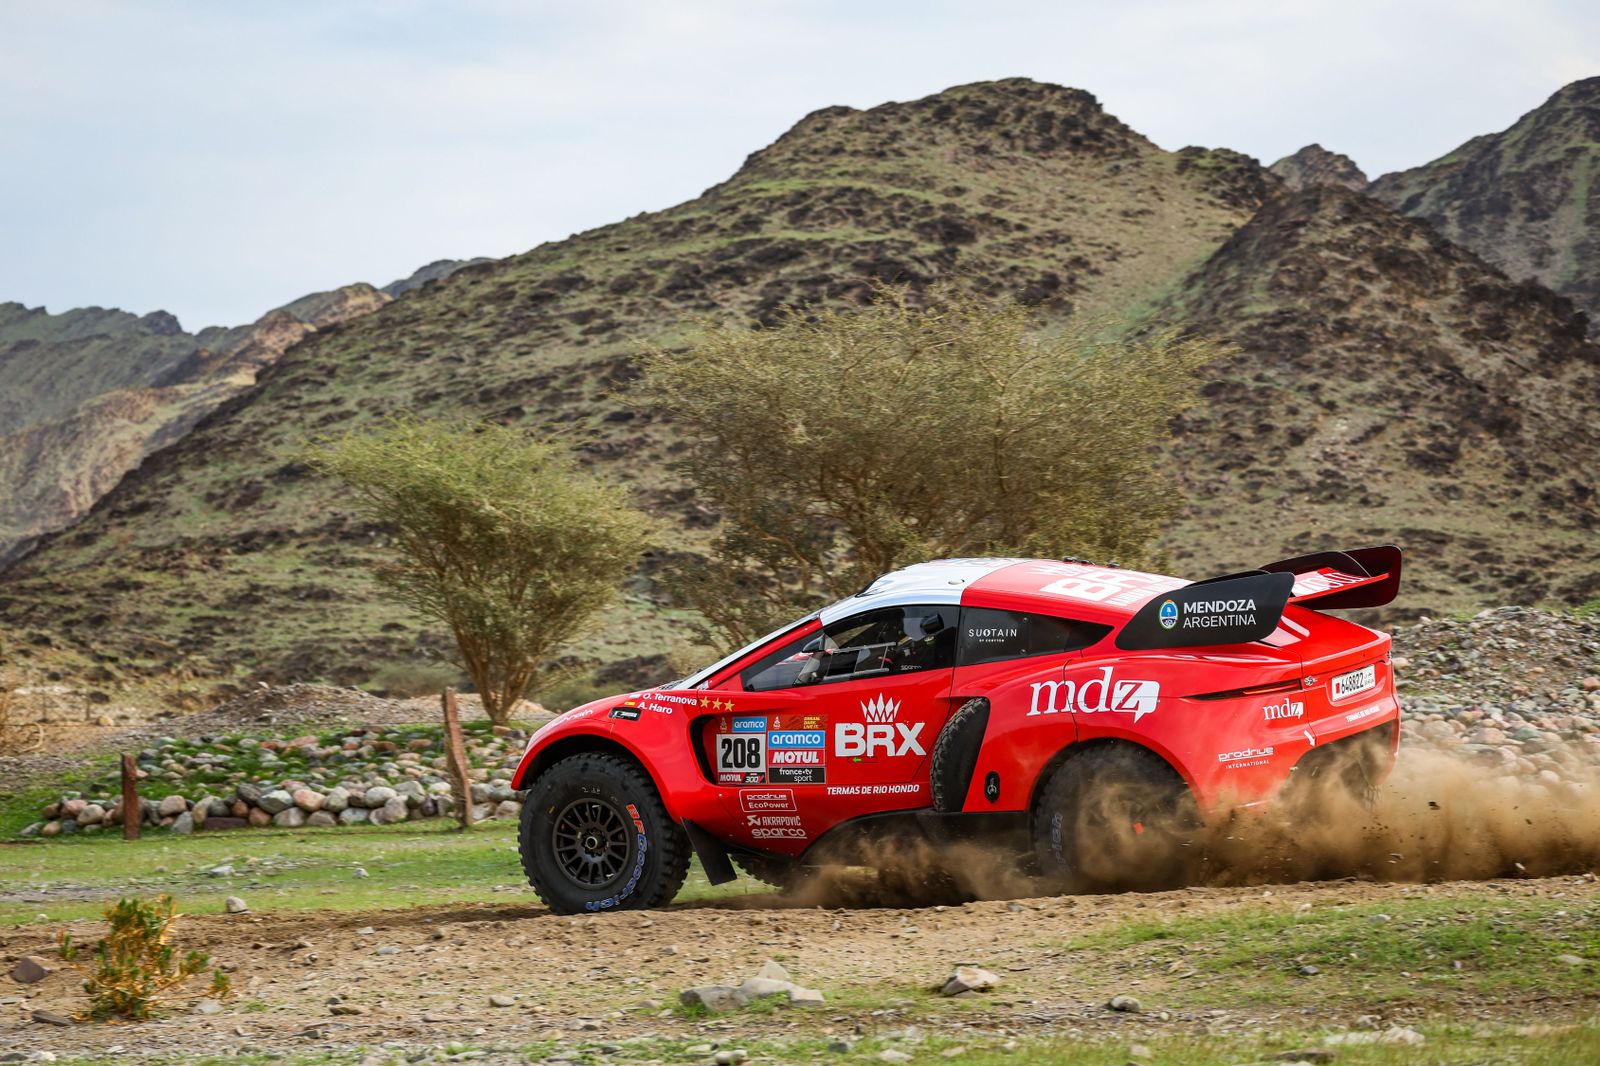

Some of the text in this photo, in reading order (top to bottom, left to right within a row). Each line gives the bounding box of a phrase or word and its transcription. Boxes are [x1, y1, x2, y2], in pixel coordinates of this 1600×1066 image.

[1183, 599, 1257, 614] MENDOZA
[1182, 613, 1257, 629] ARGENTINA
[642, 692, 698, 706] O. Terranova
[1026, 666, 1160, 720] mdz
[637, 701, 673, 715] A. Haro
[1262, 697, 1304, 720] mdz
[734, 720, 765, 729] aramco
[771, 733, 821, 745] aramco
[835, 722, 927, 758] BRX
[721, 738, 761, 769] 208
[772, 751, 820, 764] MOTUL
[1218, 747, 1274, 762] prodrive
[720, 773, 742, 782] MOTUL
[794, 774, 813, 784] sport
[827, 784, 920, 796] TERMAS DE RIO HONDO
[751, 828, 808, 839] sparco
